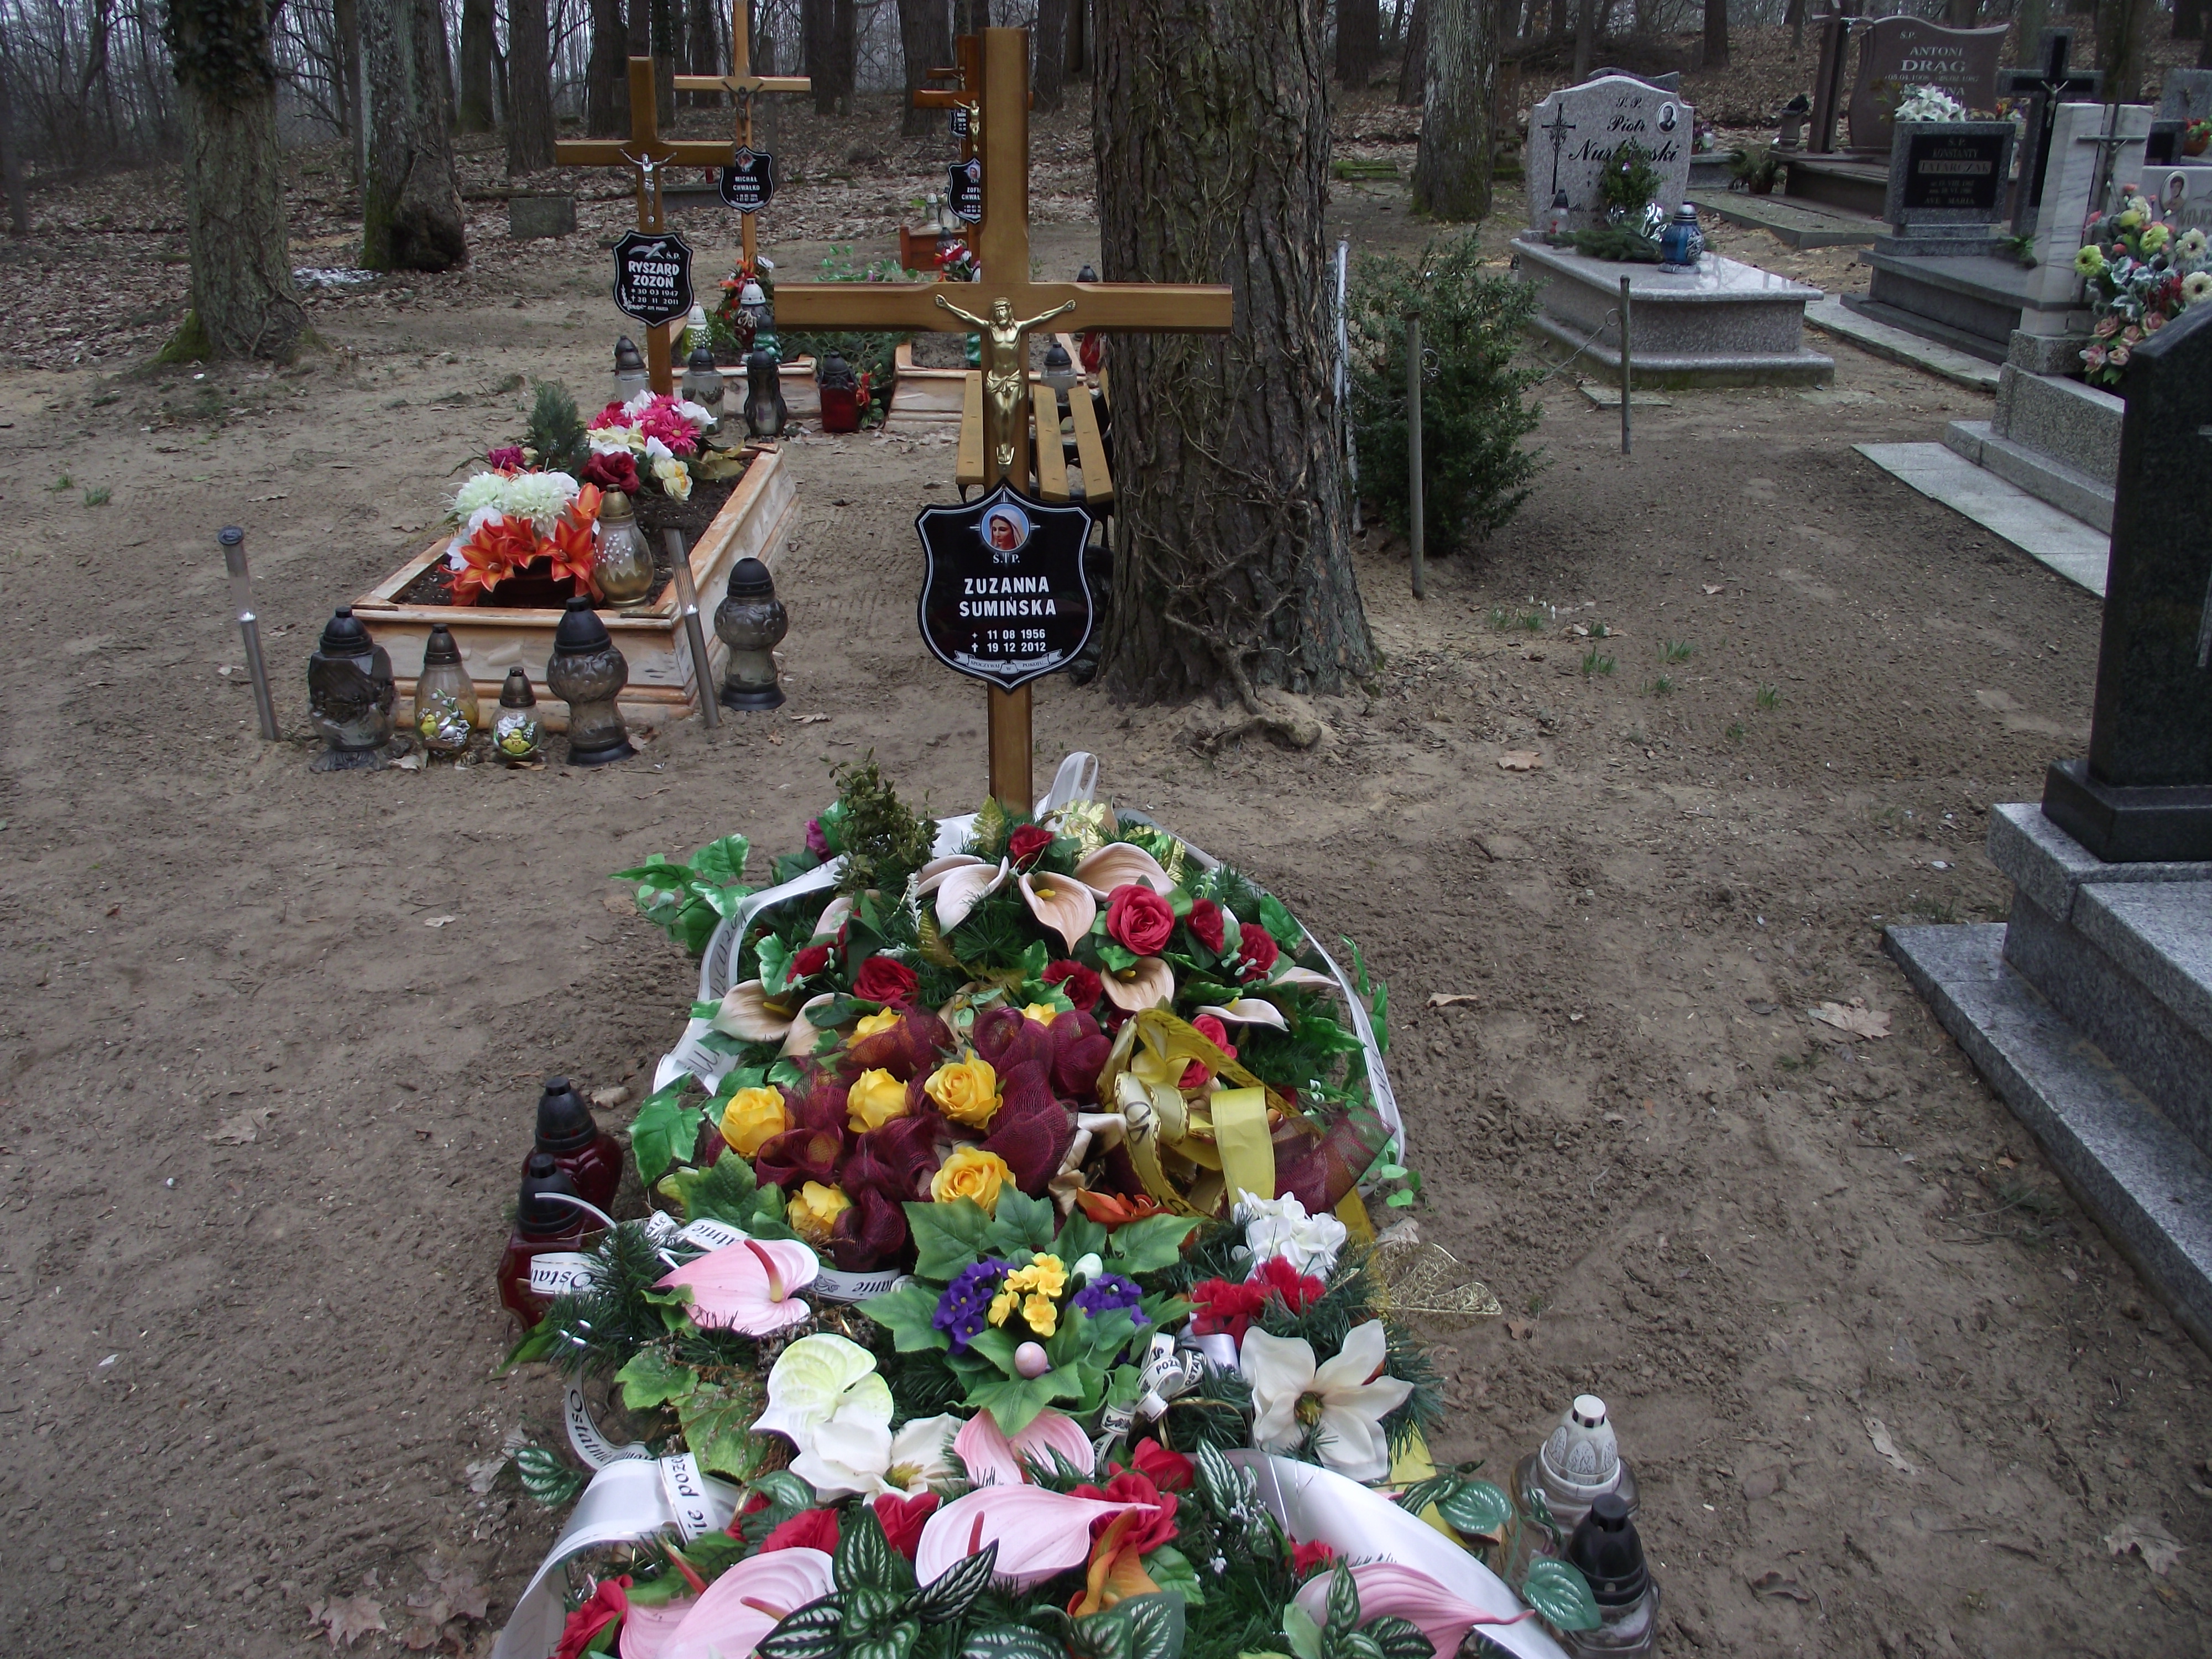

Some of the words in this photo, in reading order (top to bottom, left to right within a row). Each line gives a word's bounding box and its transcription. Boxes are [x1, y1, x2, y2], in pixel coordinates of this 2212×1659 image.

[1910, 46, 1963, 56] ANTONI
[1607, 114, 1647, 132] Piotr
[1568, 138, 1681, 162] Nurski
[1933, 148, 1979, 158] KONSTANTY
[628, 260, 680, 276] RYSZARD
[964, 576, 1050, 594] ZUZANNA
[959, 596, 1056, 617] SUMIŃSKA
[987, 630, 998, 640] 11
[1002, 629, 1015, 640] 08
[1021, 629, 1046, 639] 1956
[987, 643, 999, 653] 19
[1003, 643, 1016, 653] 12
[1021, 641, 1046, 652] 2012
